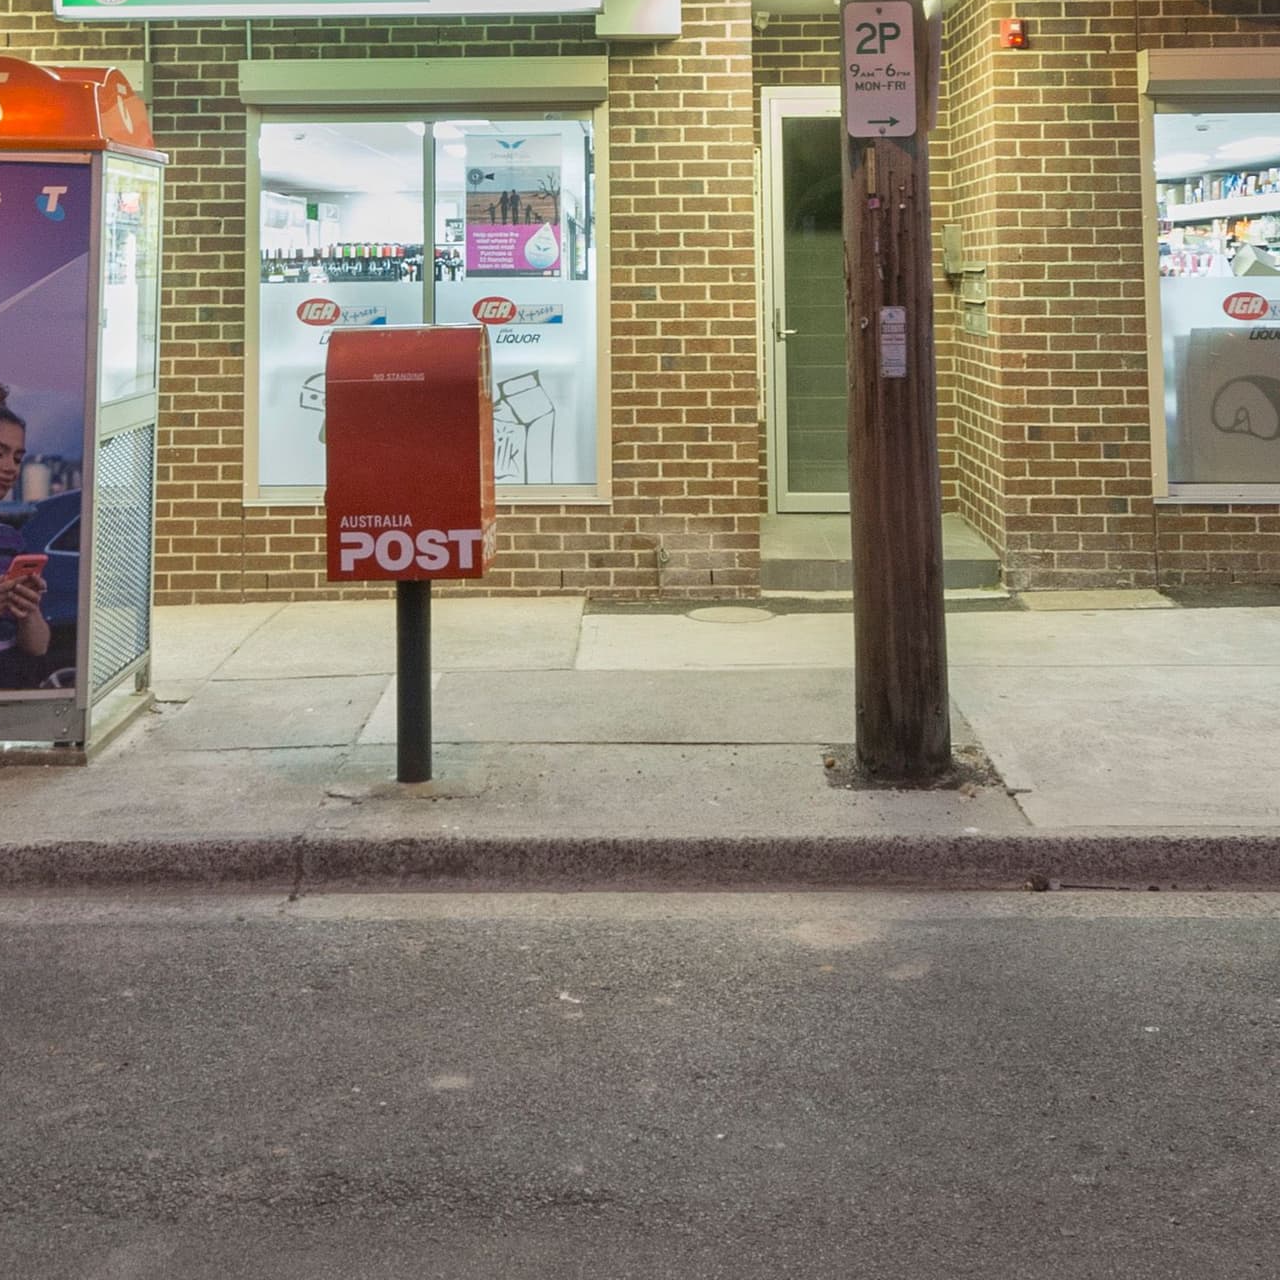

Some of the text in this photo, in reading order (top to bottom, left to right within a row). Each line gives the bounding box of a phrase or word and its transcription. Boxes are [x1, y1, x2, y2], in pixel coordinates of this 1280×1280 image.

[854, 22, 901, 55] 2P
[855, 80, 906, 92] MON-FRI
[300, 302, 336, 321] IGA
[477, 301, 513, 319] IGA
[1228, 296, 1265, 314] IGA
[496, 333, 541, 345] LIQUOR
[340, 515, 413, 529] AUSTRALIA
[340, 528, 482, 572] POST
